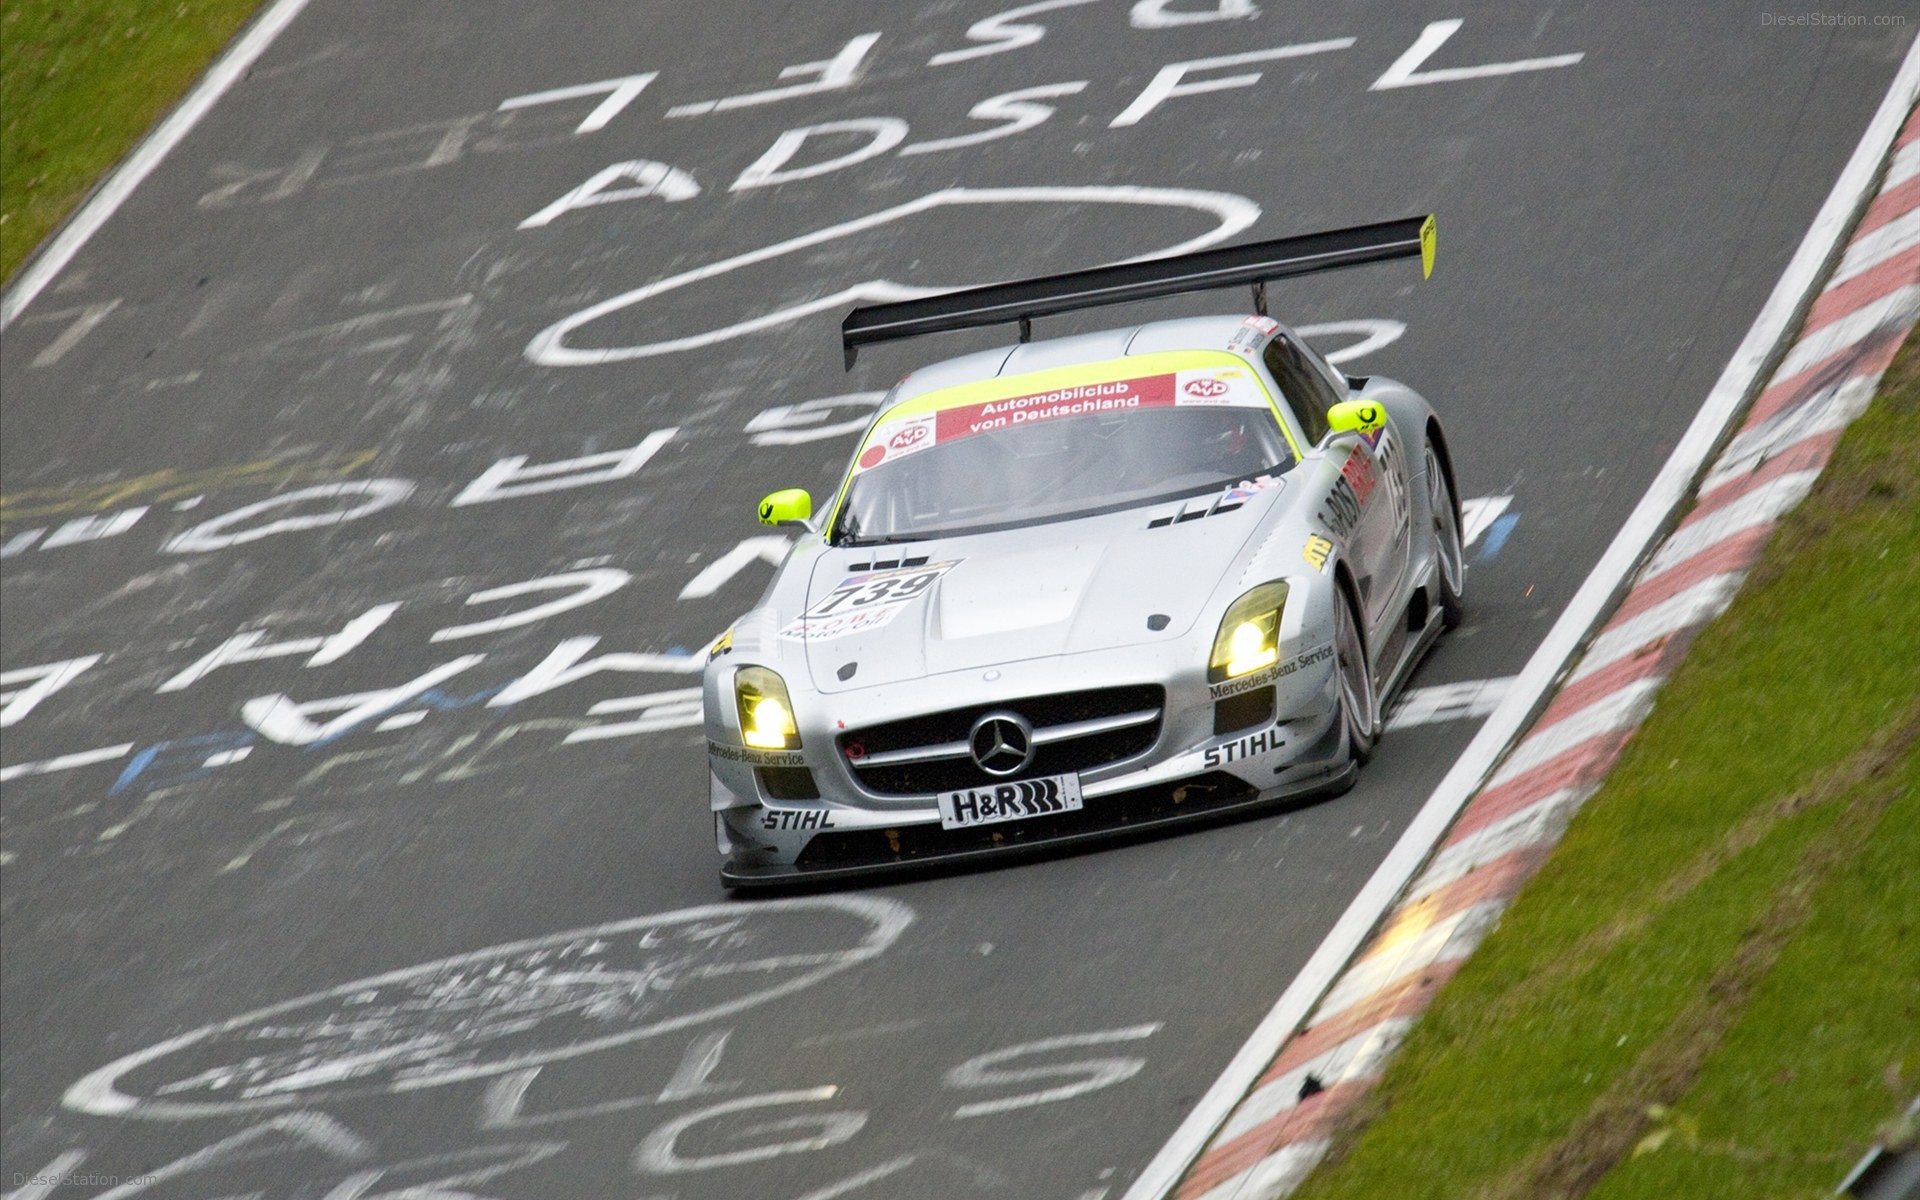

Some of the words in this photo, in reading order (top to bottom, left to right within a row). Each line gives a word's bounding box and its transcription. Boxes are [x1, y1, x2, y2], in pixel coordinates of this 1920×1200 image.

[969, 416, 1007, 433] von
[1012, 395, 1140, 424] Deutschland
[980, 381, 1129, 416] Automobilclub
[817, 571, 941, 614] 739
[780, 625, 845, 640] Motor
[852, 616, 885, 631] Oil
[1208, 662, 1297, 700] Mercedes-Benz
[1298, 645, 1334, 669] Service
[708, 741, 762, 764] Mercedes-Benz
[764, 752, 805, 766] Service
[1203, 731, 1286, 769] STIHL
[763, 809, 836, 830] STIHL
